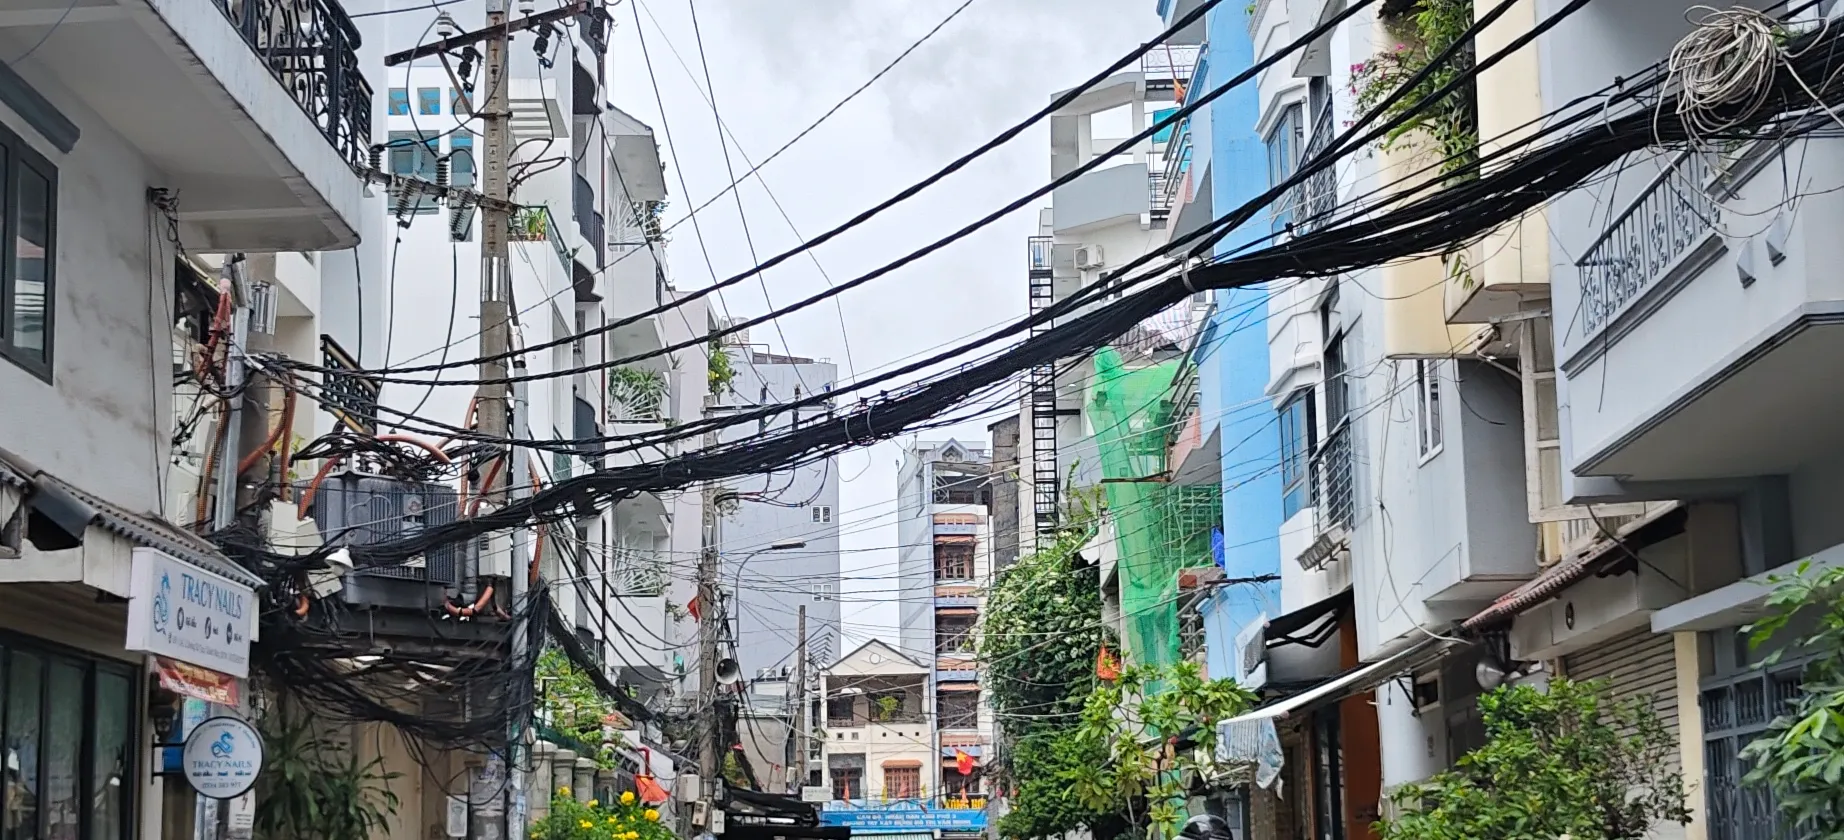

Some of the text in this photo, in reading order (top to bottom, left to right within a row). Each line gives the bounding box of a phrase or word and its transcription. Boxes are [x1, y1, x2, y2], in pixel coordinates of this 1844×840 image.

[182, 573, 243, 620] TRACY NAILS
[193, 760, 253, 769] TRACY NAILS
